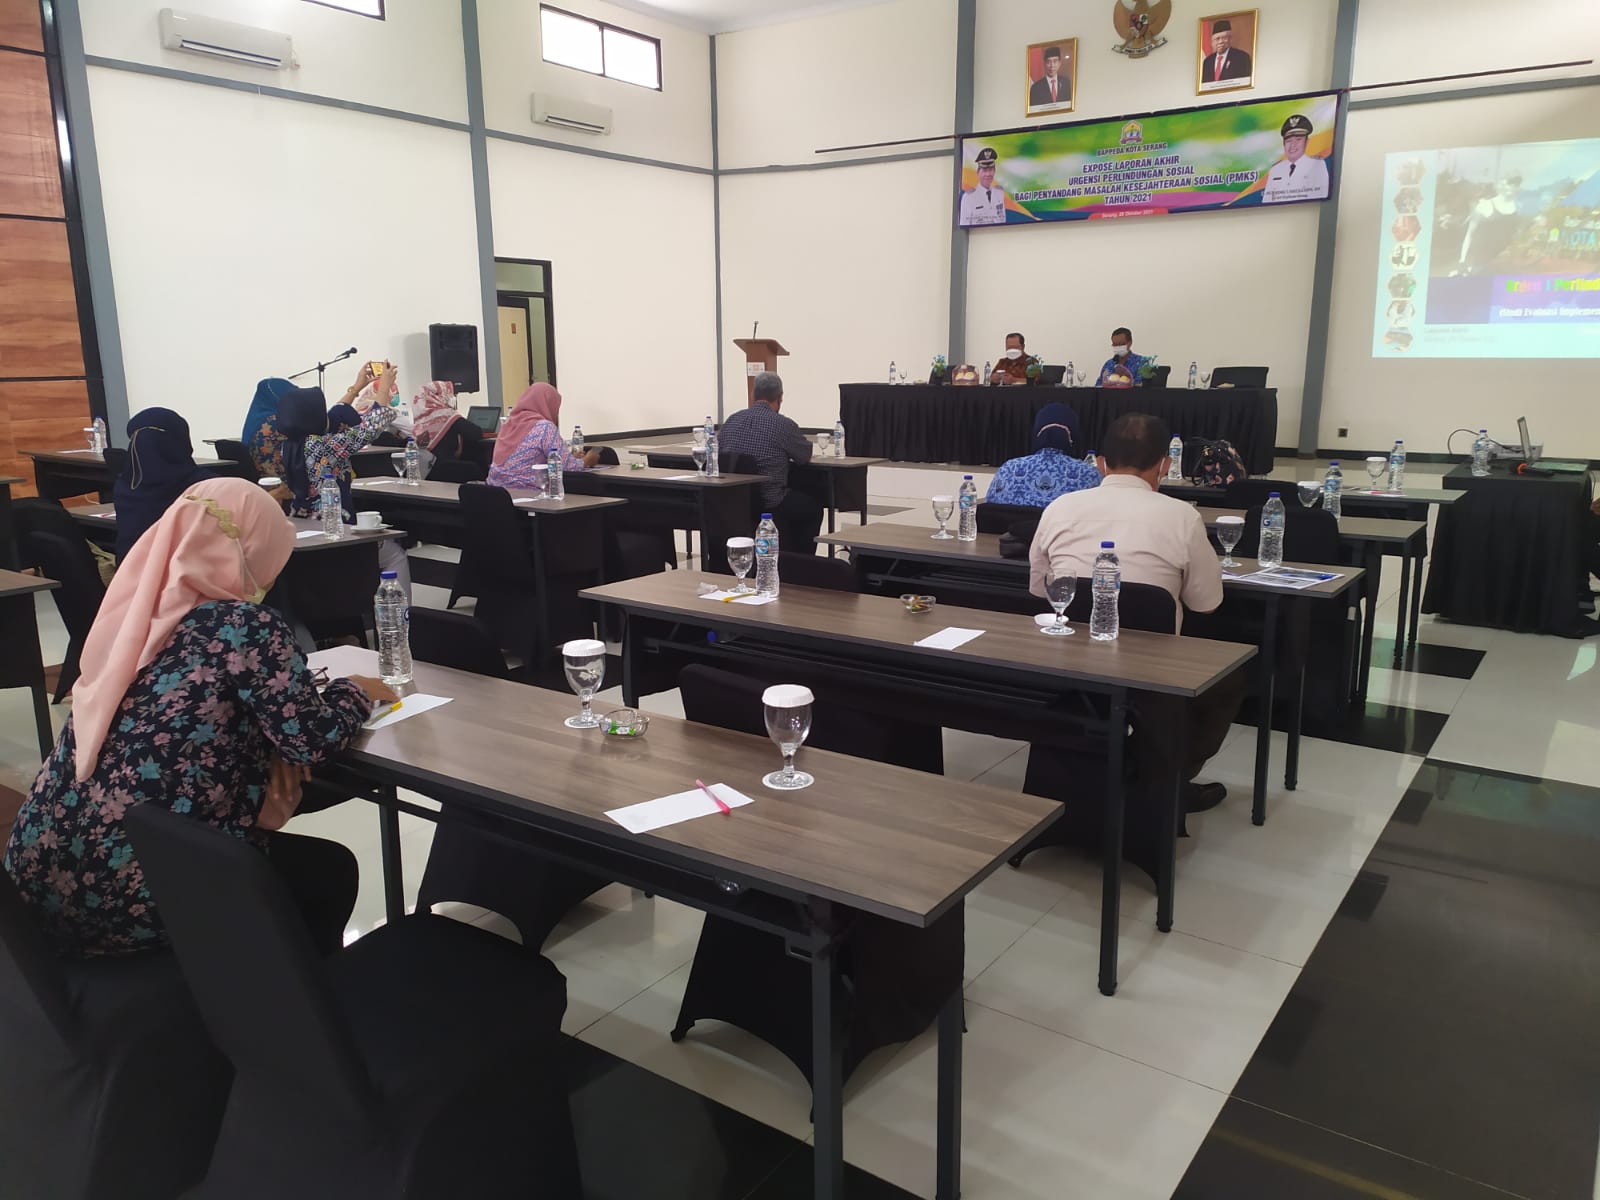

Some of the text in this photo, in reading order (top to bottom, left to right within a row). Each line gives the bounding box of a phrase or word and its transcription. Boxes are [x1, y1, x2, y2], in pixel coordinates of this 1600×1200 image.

[1097, 142, 1168, 156] BAPPEDA KOTA SERANG
[1083, 155, 1180, 173] EXPOSE LAPORAN AKHIR
[1068, 165, 1194, 185] URGENSI PERLINDUNGAN SOSIAL
[1014, 171, 1259, 201] BAGI PENYANDANG MASALAH KESEJAHTERAAN SOSIAL (PMKS)
[1104, 193, 1152, 205] TAHUN 2021
